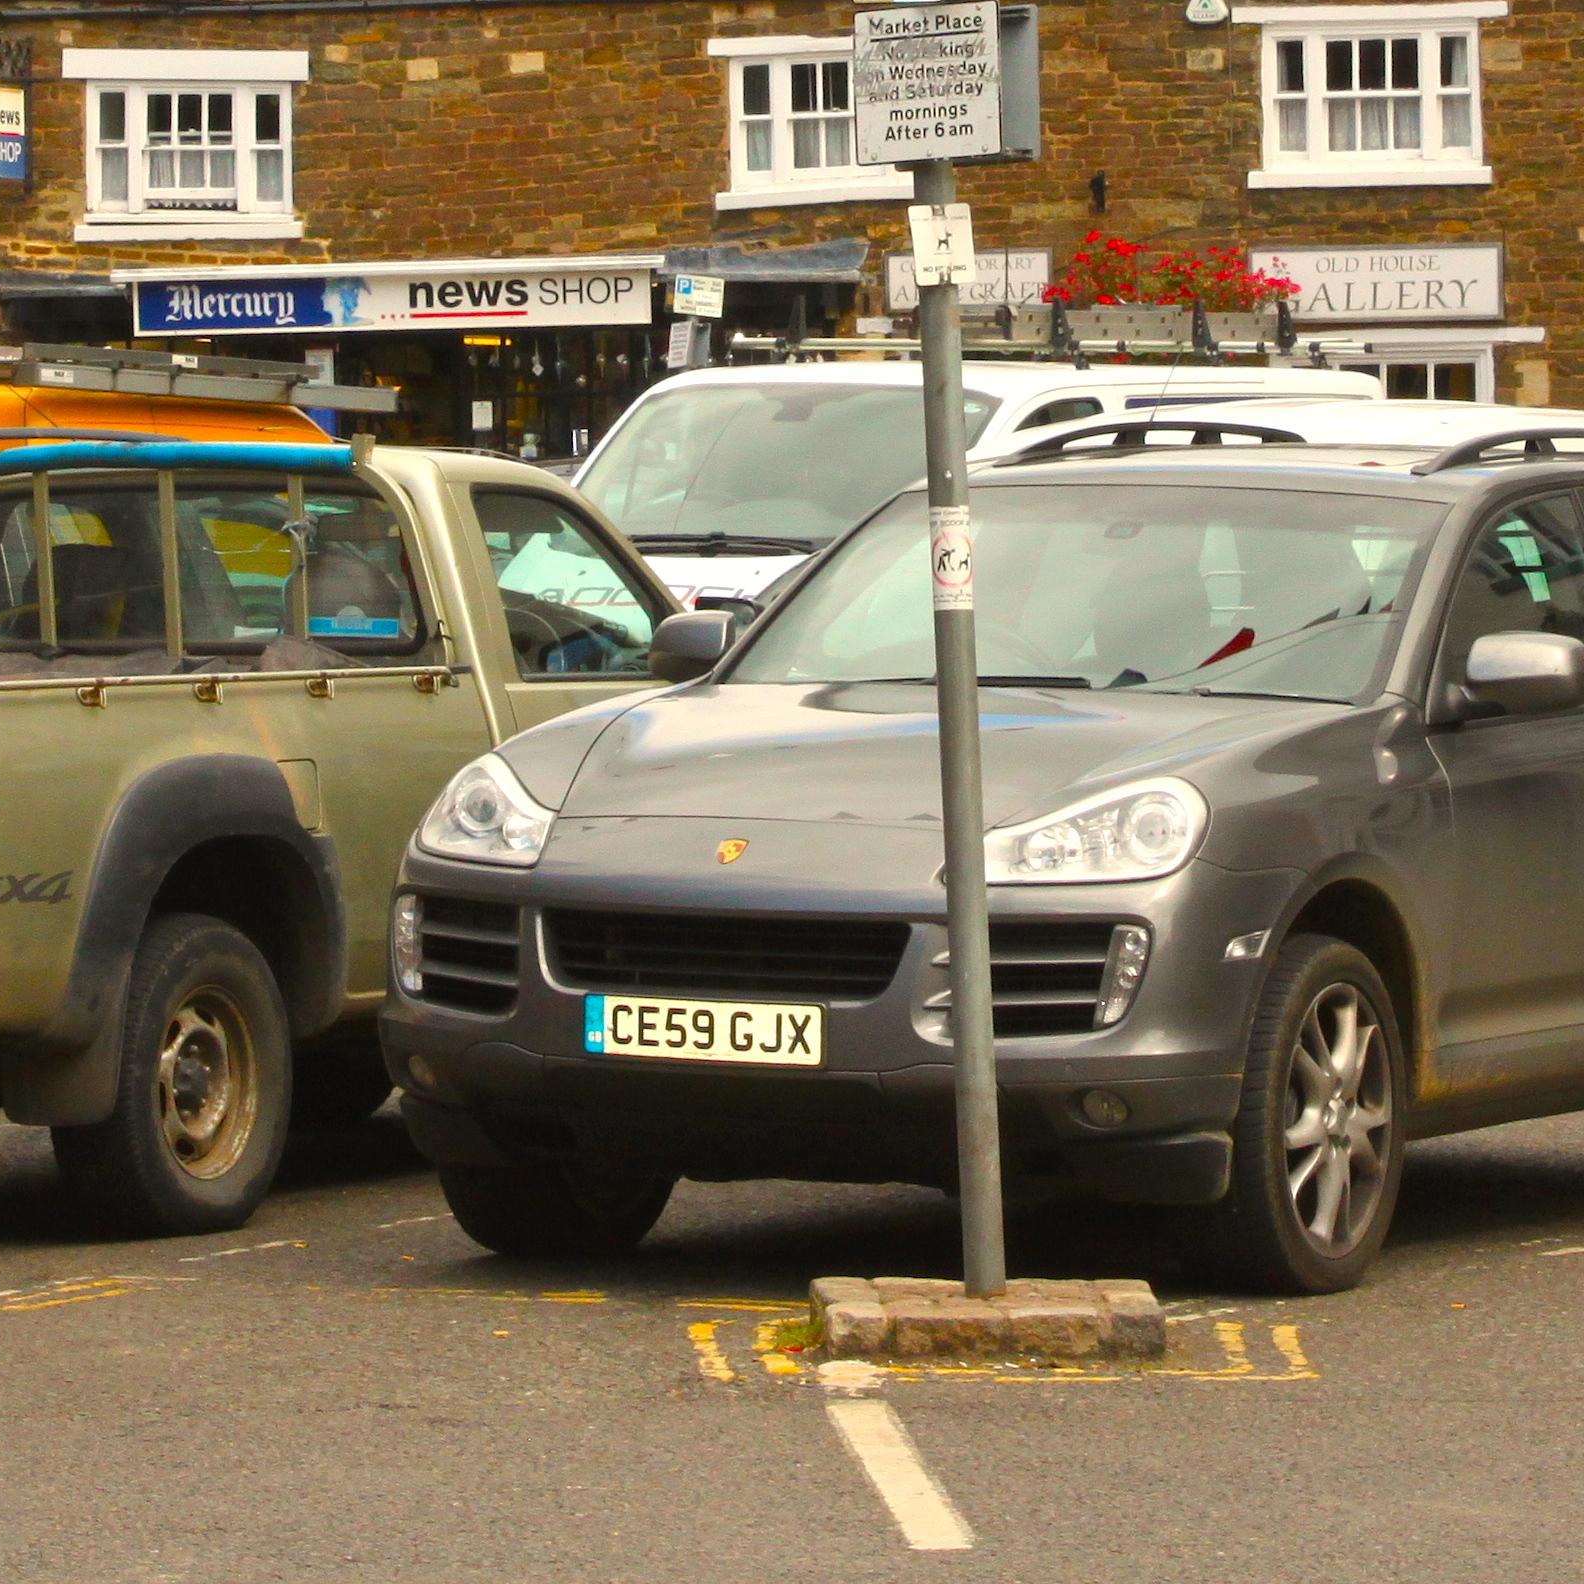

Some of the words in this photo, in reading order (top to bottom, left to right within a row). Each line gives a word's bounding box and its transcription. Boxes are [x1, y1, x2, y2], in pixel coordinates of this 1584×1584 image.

[869, 16, 929, 35] Market
[935, 14, 984, 32] Place
[890, 60, 988, 81] Wednesday
[905, 82, 984, 101] Saturday
[889, 102, 968, 122] mornings
[884, 124, 930, 142] After
[1316, 255, 1360, 274] OLD
[1368, 254, 1442, 274] HOUSE
[165, 284, 296, 326] Mercury
[409, 277, 529, 310] news
[539, 275, 634, 307] SHOP
[611, 1004, 715, 1050] CE59
[729, 1011, 812, 1055] GJX
